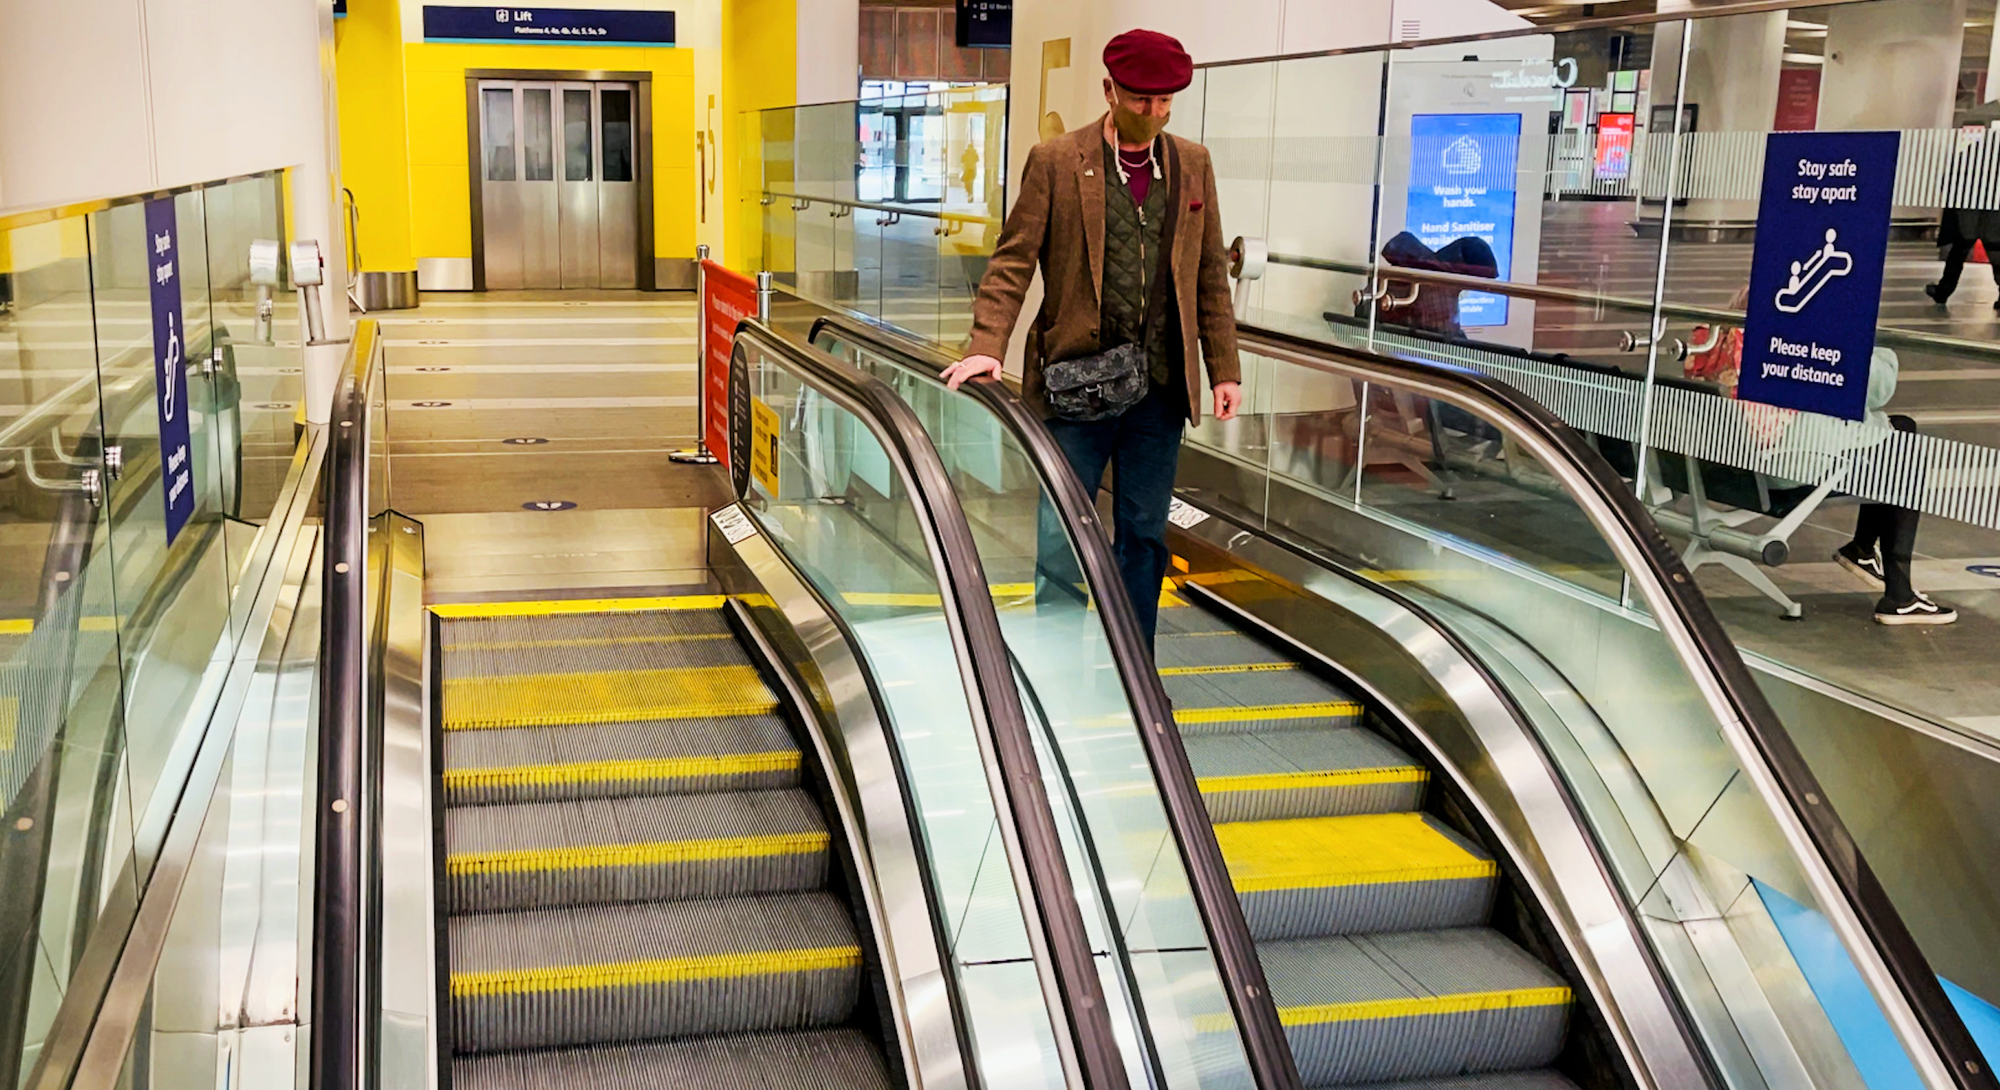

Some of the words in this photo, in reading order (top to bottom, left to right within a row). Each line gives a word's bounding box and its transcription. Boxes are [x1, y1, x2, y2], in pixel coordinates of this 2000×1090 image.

[513, 10, 533, 22] Lift
[513, 26, 544, 34] Platforms
[1797, 158, 1828, 181] Stay
[1828, 158, 1858, 177] safe
[1433, 184, 1462, 196] Wash
[1792, 183, 1820, 204] stay
[1821, 184, 1857, 205] apart
[1443, 196, 1476, 208] hands.
[1421, 221, 1450, 233] Hand
[1451, 220, 1496, 232] Sanitiser
[1769, 336, 1809, 358] Please
[1810, 341, 1841, 367] keep
[1761, 362, 1790, 379] your
[1791, 362, 1845, 387] distance
